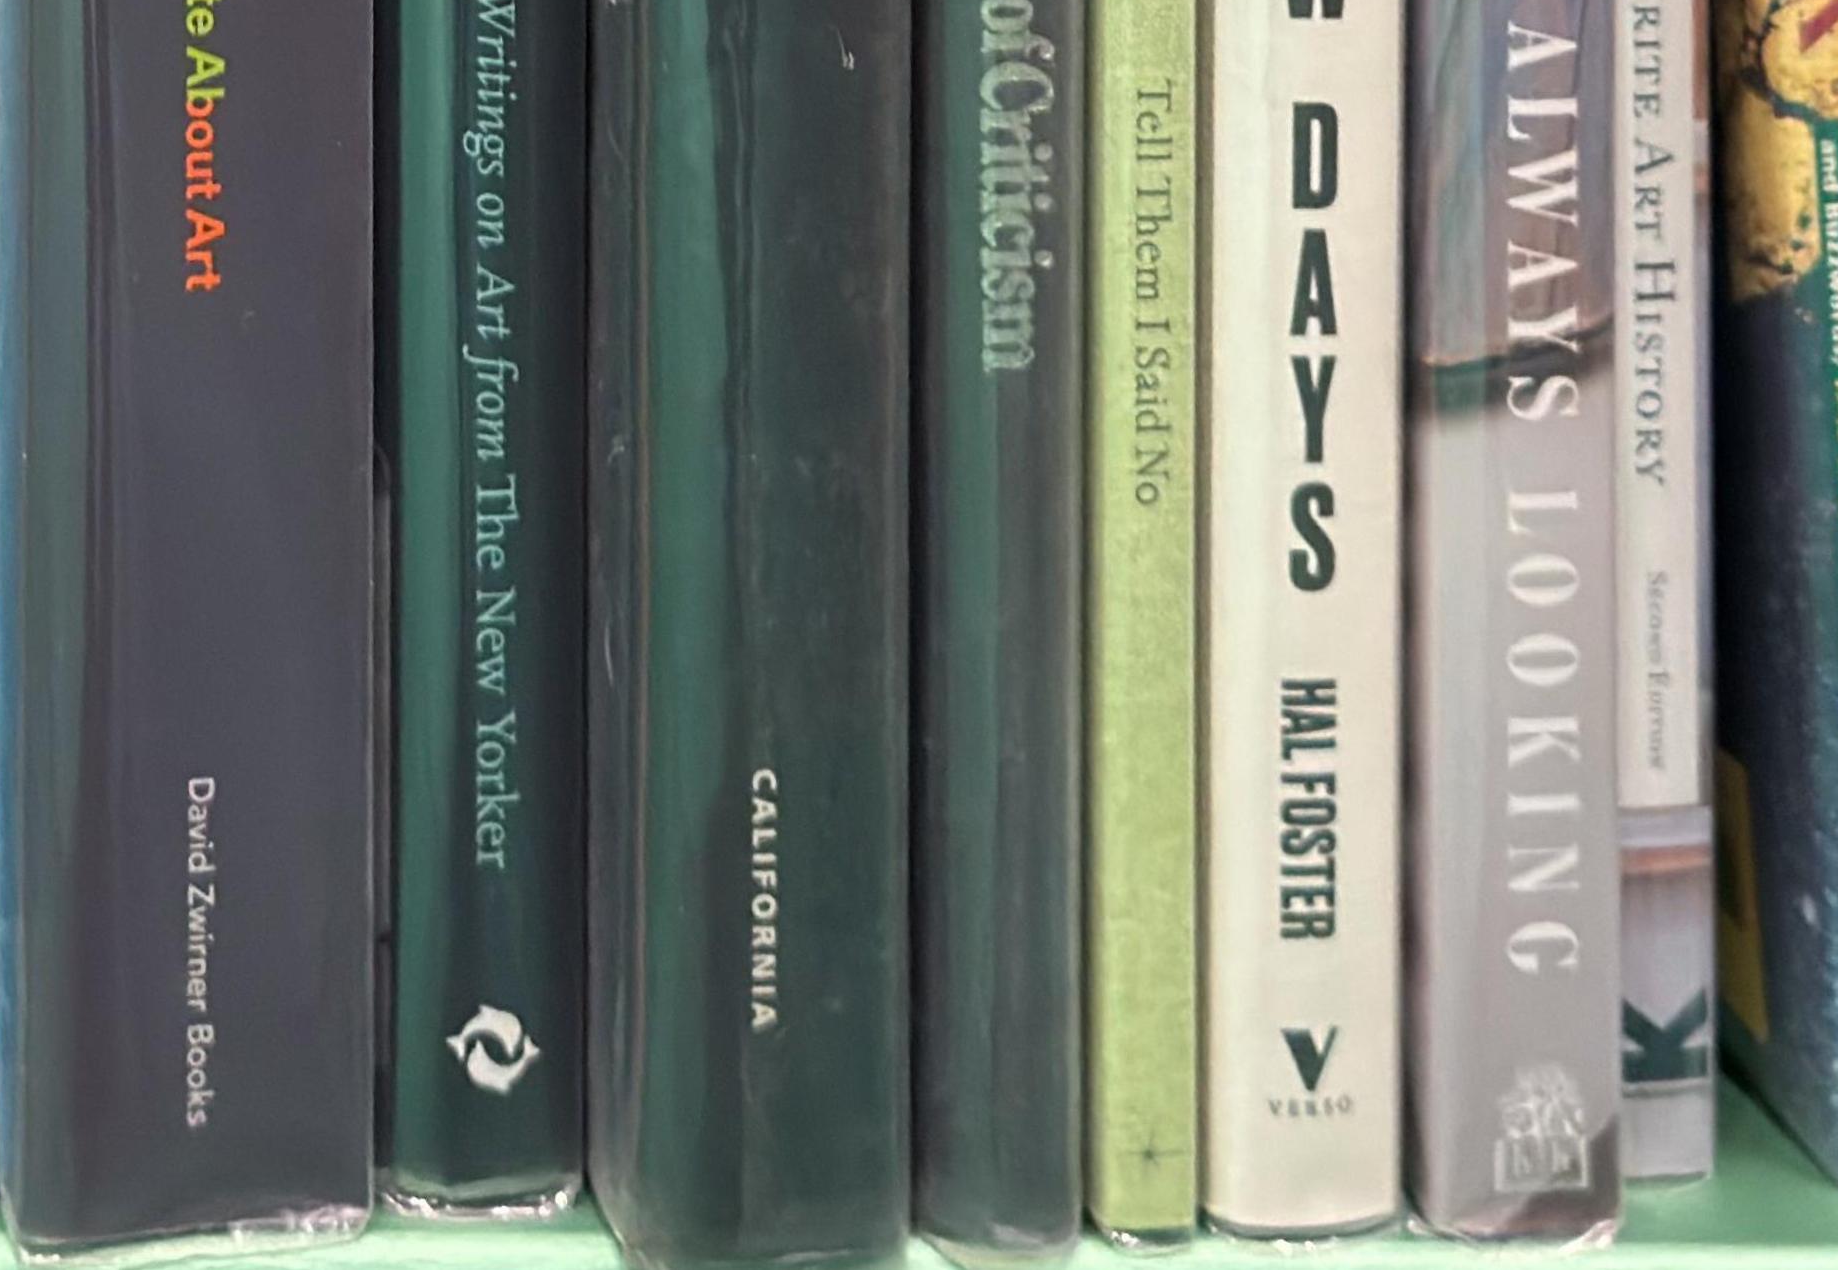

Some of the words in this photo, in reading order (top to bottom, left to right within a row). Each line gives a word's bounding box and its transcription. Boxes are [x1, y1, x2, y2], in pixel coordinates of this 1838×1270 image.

[185, 46, 227, 198] About
[979, 62, 1056, 373] Criticism
[1136, 183, 1173, 300] Them
[1504, 21, 1580, 423] ALWAYS
[1289, 101, 1341, 592] DAYS
[476, 473, 518, 565] The
[476, 588, 517, 695] New
[476, 710, 517, 868] Yorker
[1281, 679, 1337, 760] HAL
[1504, 487, 1581, 975] LOOKING
[187, 777, 215, 872] David
[750, 769, 779, 1029] CALIFORNIA
[1280, 774, 1338, 940] FOSTER
[187, 1023, 215, 1127] Books
[1270, 1097, 1352, 1117] VERSO
